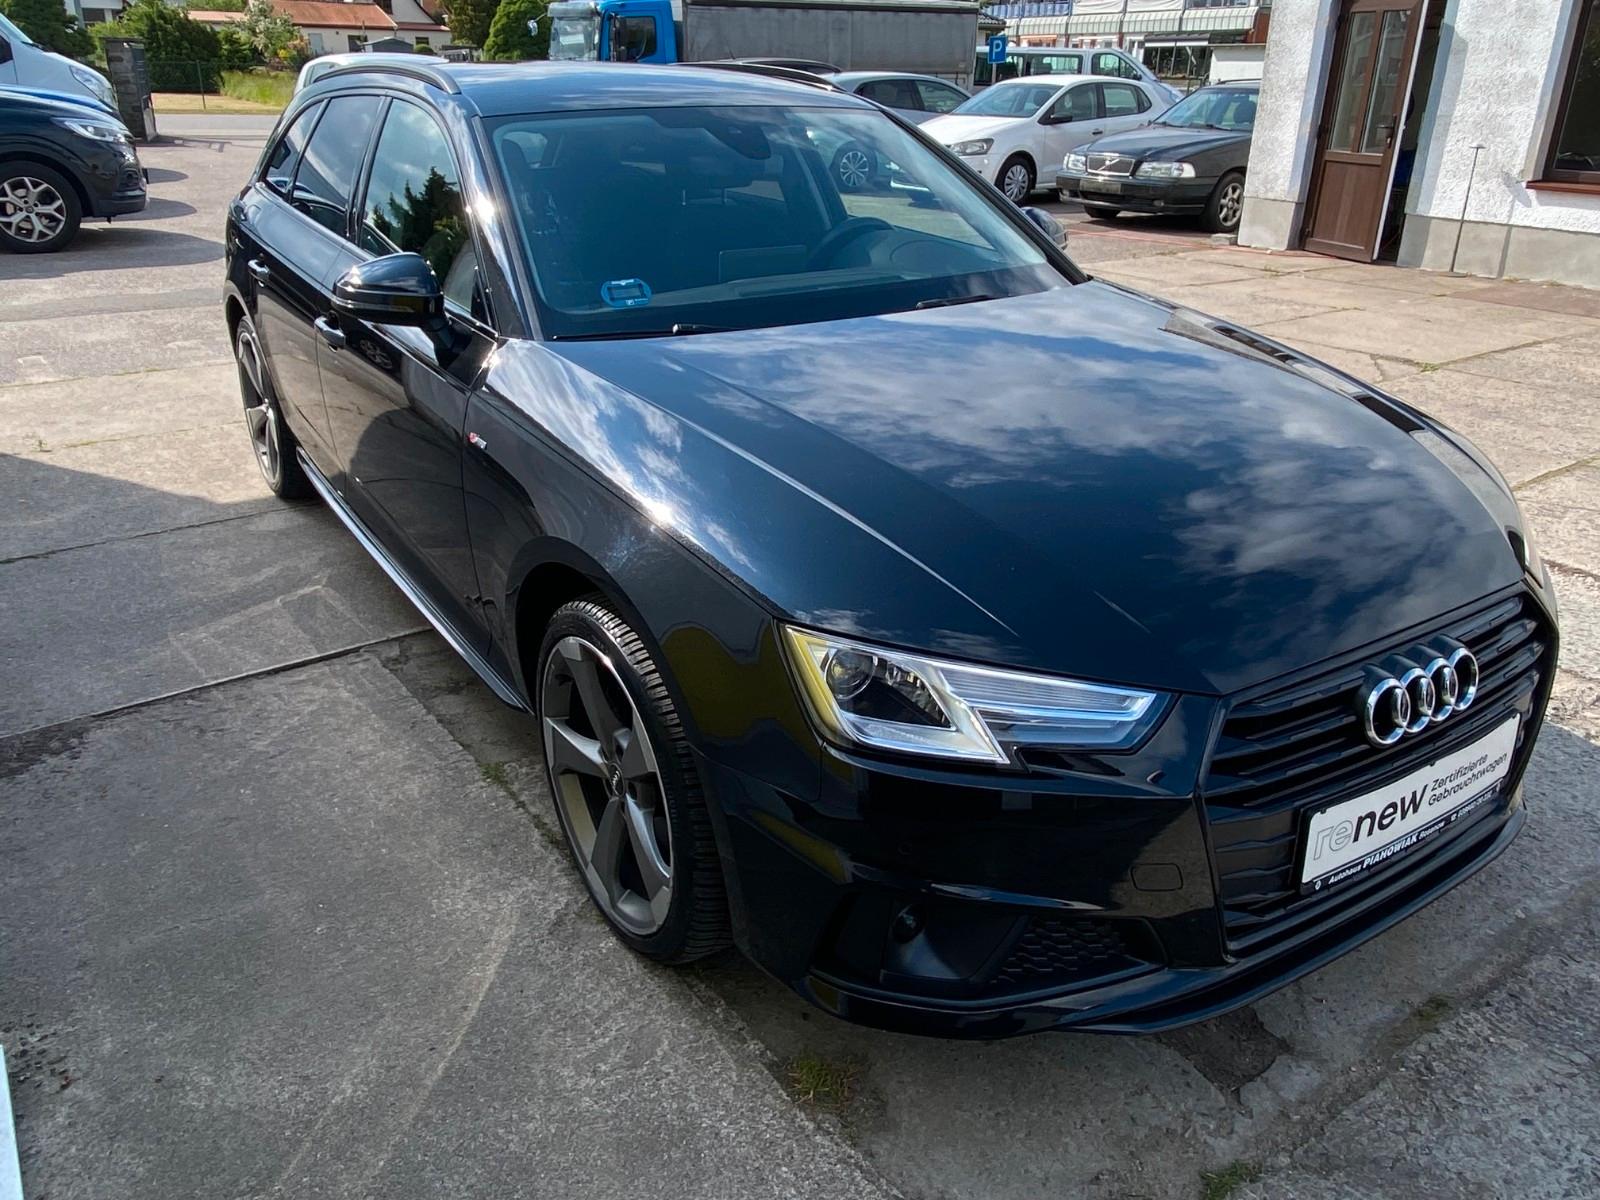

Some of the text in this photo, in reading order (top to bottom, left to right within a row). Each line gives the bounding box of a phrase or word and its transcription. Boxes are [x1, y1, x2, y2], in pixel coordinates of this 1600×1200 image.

[993, 40, 1003, 60] P
[1428, 753, 1507, 806] Gebrauchtwagen
[1431, 754, 1488, 792] Zertifizierte
[1314, 783, 1429, 861] renew
[1328, 864, 1362, 885] Autohaus
